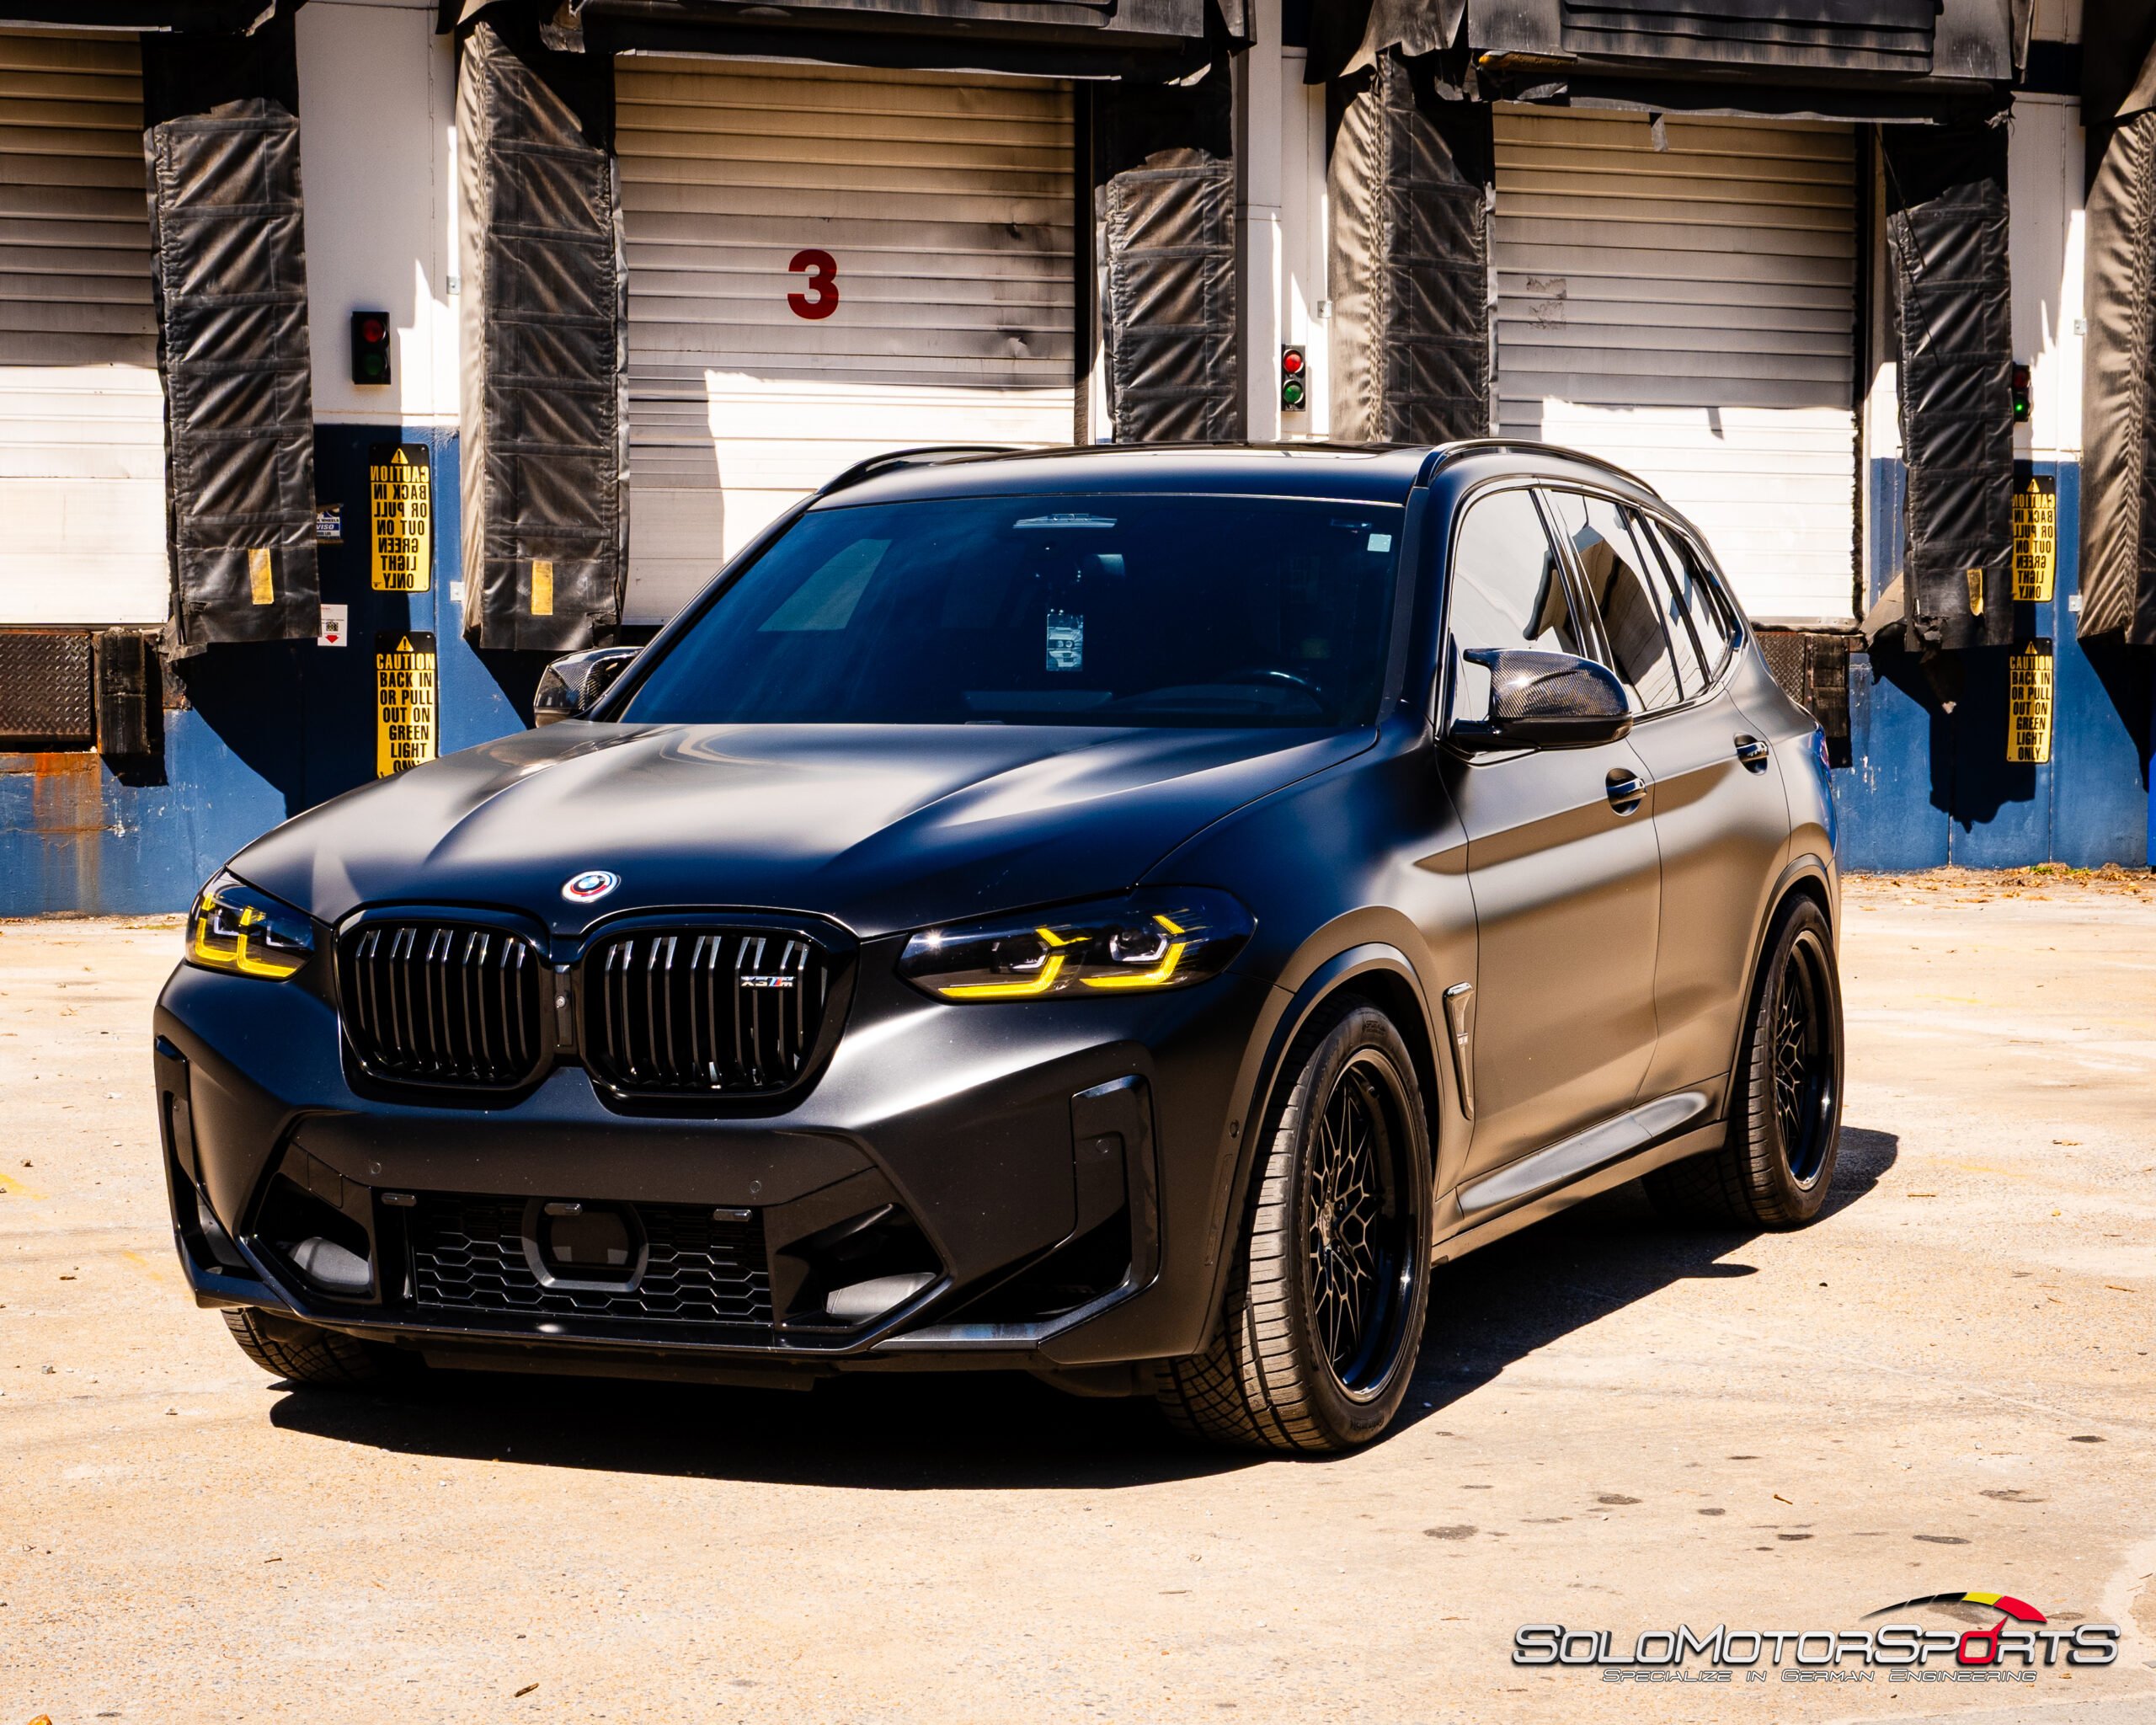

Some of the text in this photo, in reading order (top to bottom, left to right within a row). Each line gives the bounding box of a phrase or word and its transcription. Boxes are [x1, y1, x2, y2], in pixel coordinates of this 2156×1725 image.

[787, 248, 839, 320] 3
[376, 653, 435, 670] CAUTION
[2009, 655, 2053, 670] CAUTION
[380, 672, 432, 687] BACK IN
[2012, 671, 2050, 685] BACK IN
[380, 689, 433, 705] OR PULL
[2012, 686, 2051, 700] OR PULL
[383, 707, 430, 723] OUT ON
[2013, 702, 2047, 715] OUT ON
[2016, 717, 2046, 730] GREEN
[389, 724, 430, 741] GREEN
[2016, 731, 2044, 745] LIGHT
[391, 742, 427, 758] LIGHT
[2018, 747, 2041, 761] ONLY
